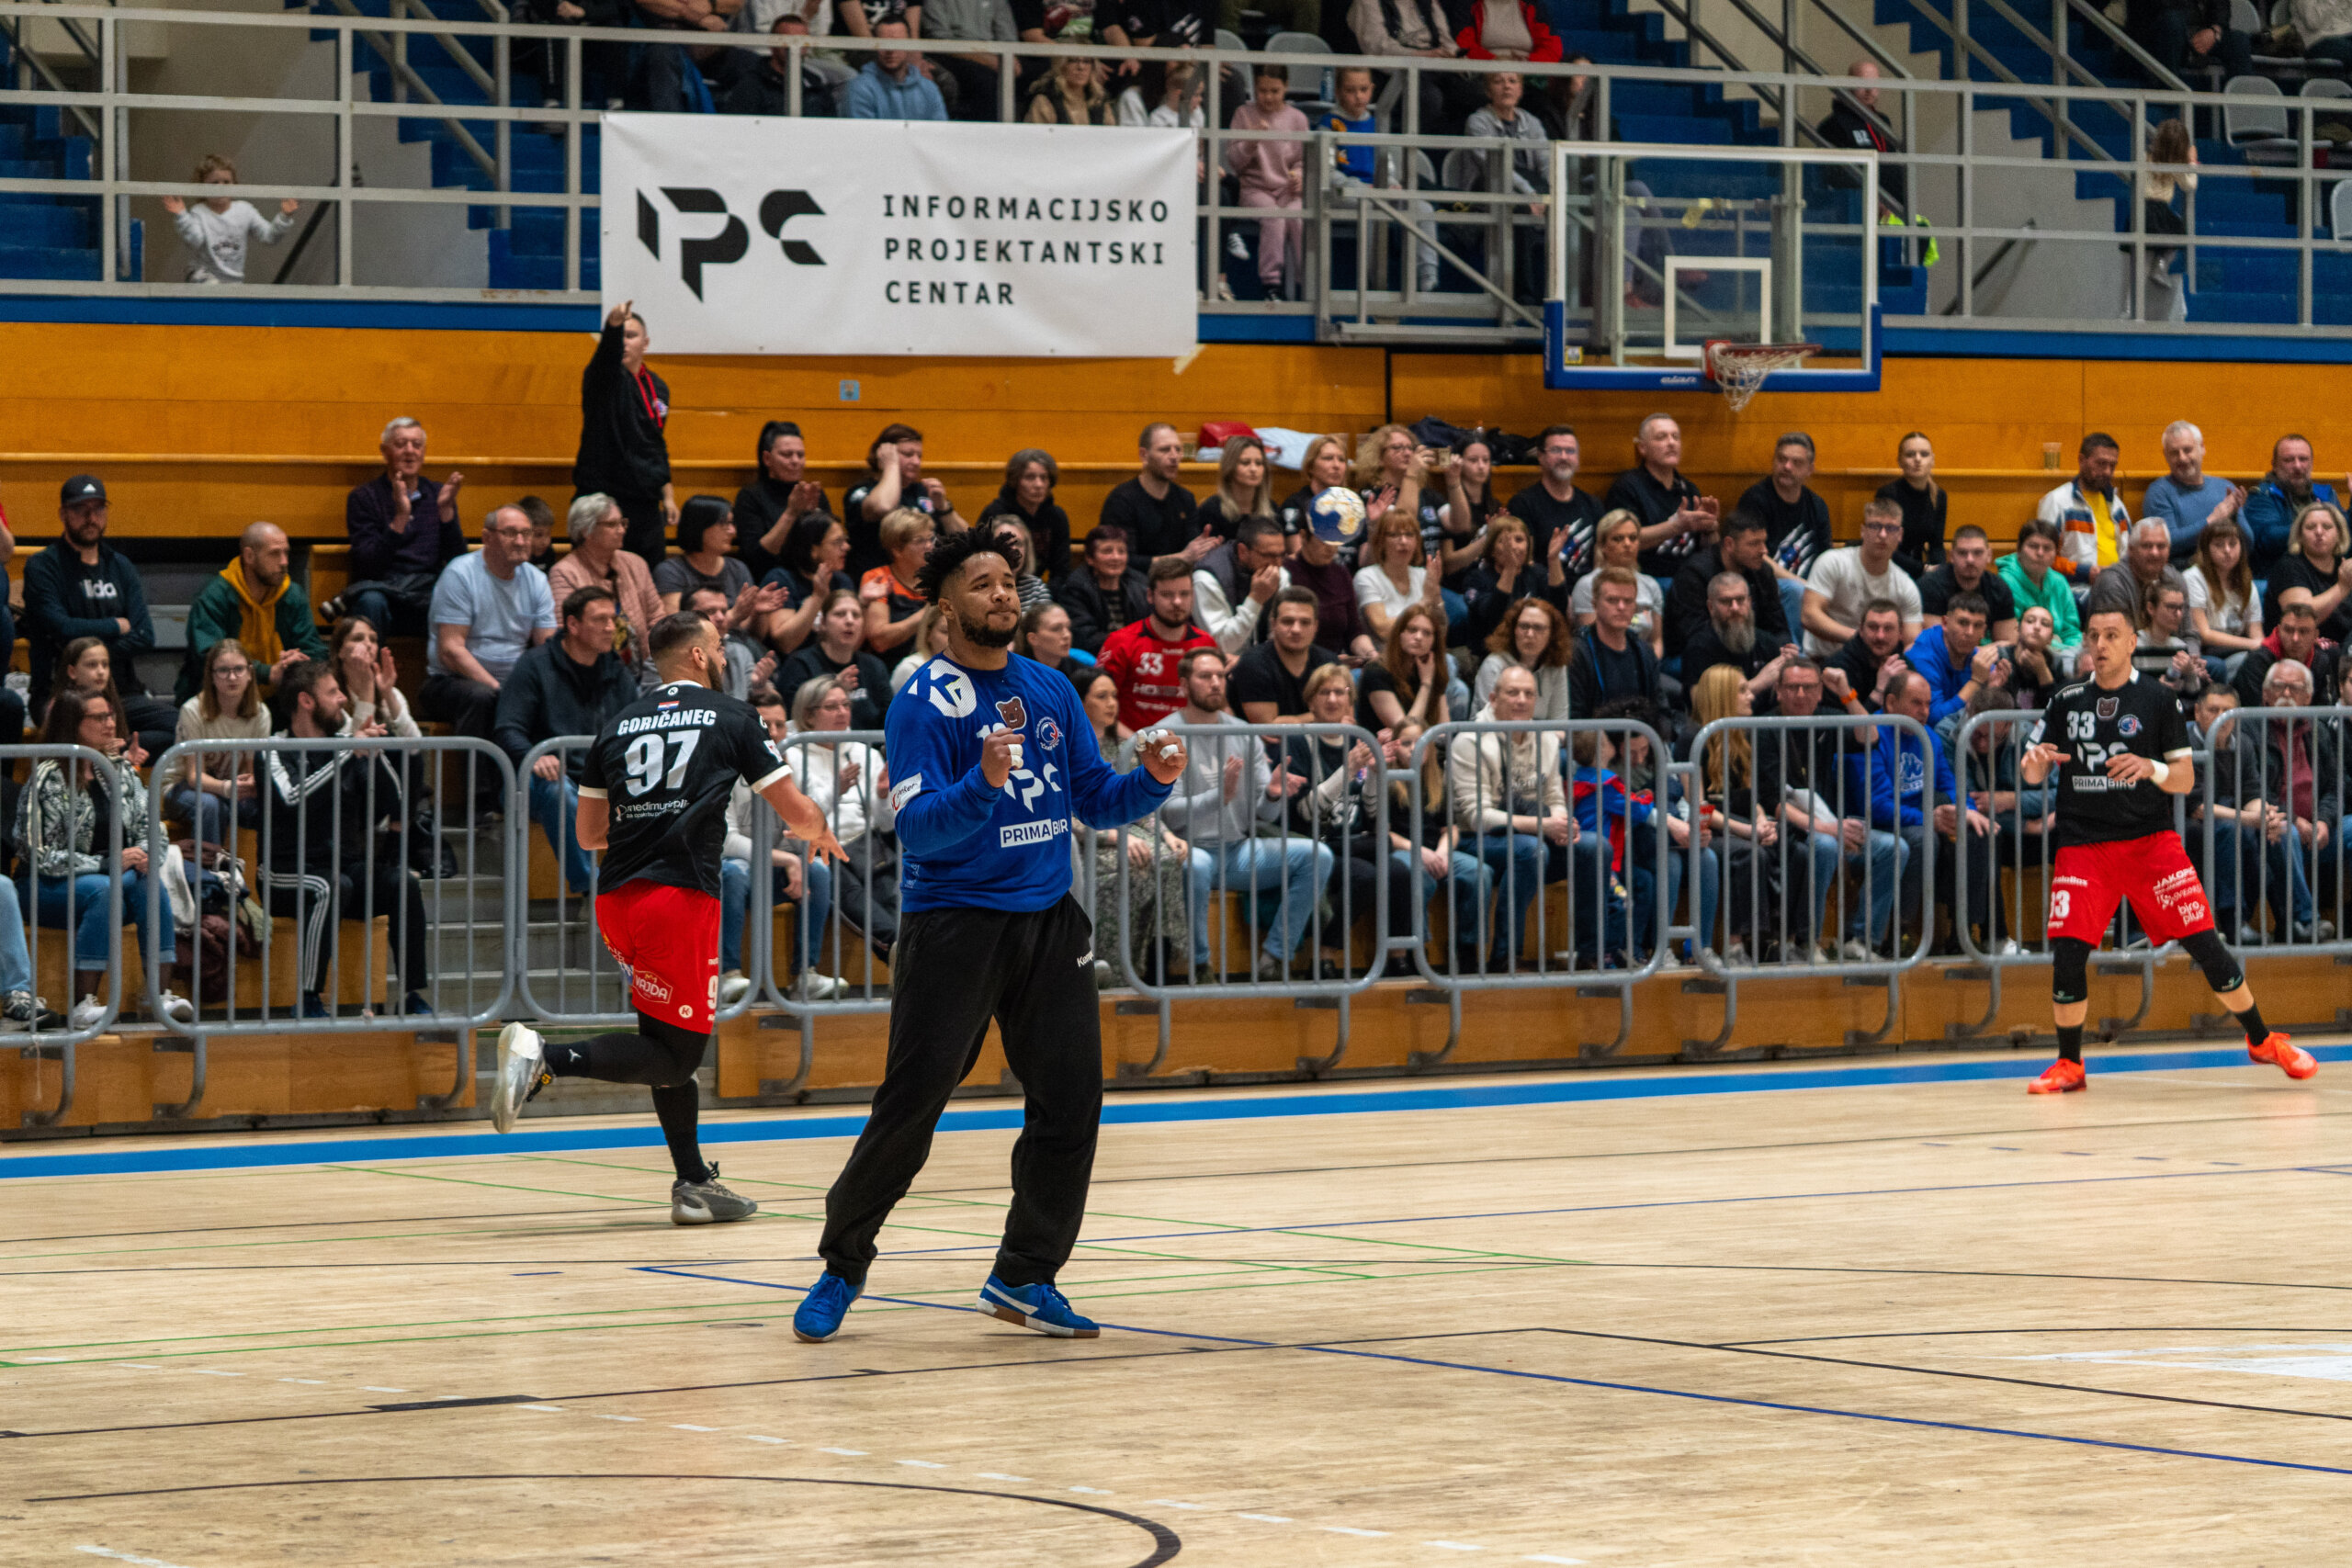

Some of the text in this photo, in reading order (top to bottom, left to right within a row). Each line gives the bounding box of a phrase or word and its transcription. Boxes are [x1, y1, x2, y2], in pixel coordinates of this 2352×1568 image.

[883, 194, 1169, 223] INFORMACIJSKO
[885, 238, 1165, 265] PROJEKTANTSKI
[885, 280, 1015, 306] CENTAR
[1135, 652, 1163, 675] 33
[617, 709, 717, 736] GORIČANEC
[2067, 711, 2096, 739] 33
[625, 729, 701, 796] 97
[2074, 777, 2105, 788] PRIMA
[1003, 818, 1069, 843] PRIMA BIR
[2050, 890, 2070, 919] 3
[2177, 900, 2199, 917] biro
[2183, 908, 2204, 926] plus
[635, 976, 668, 999] VAJDA
